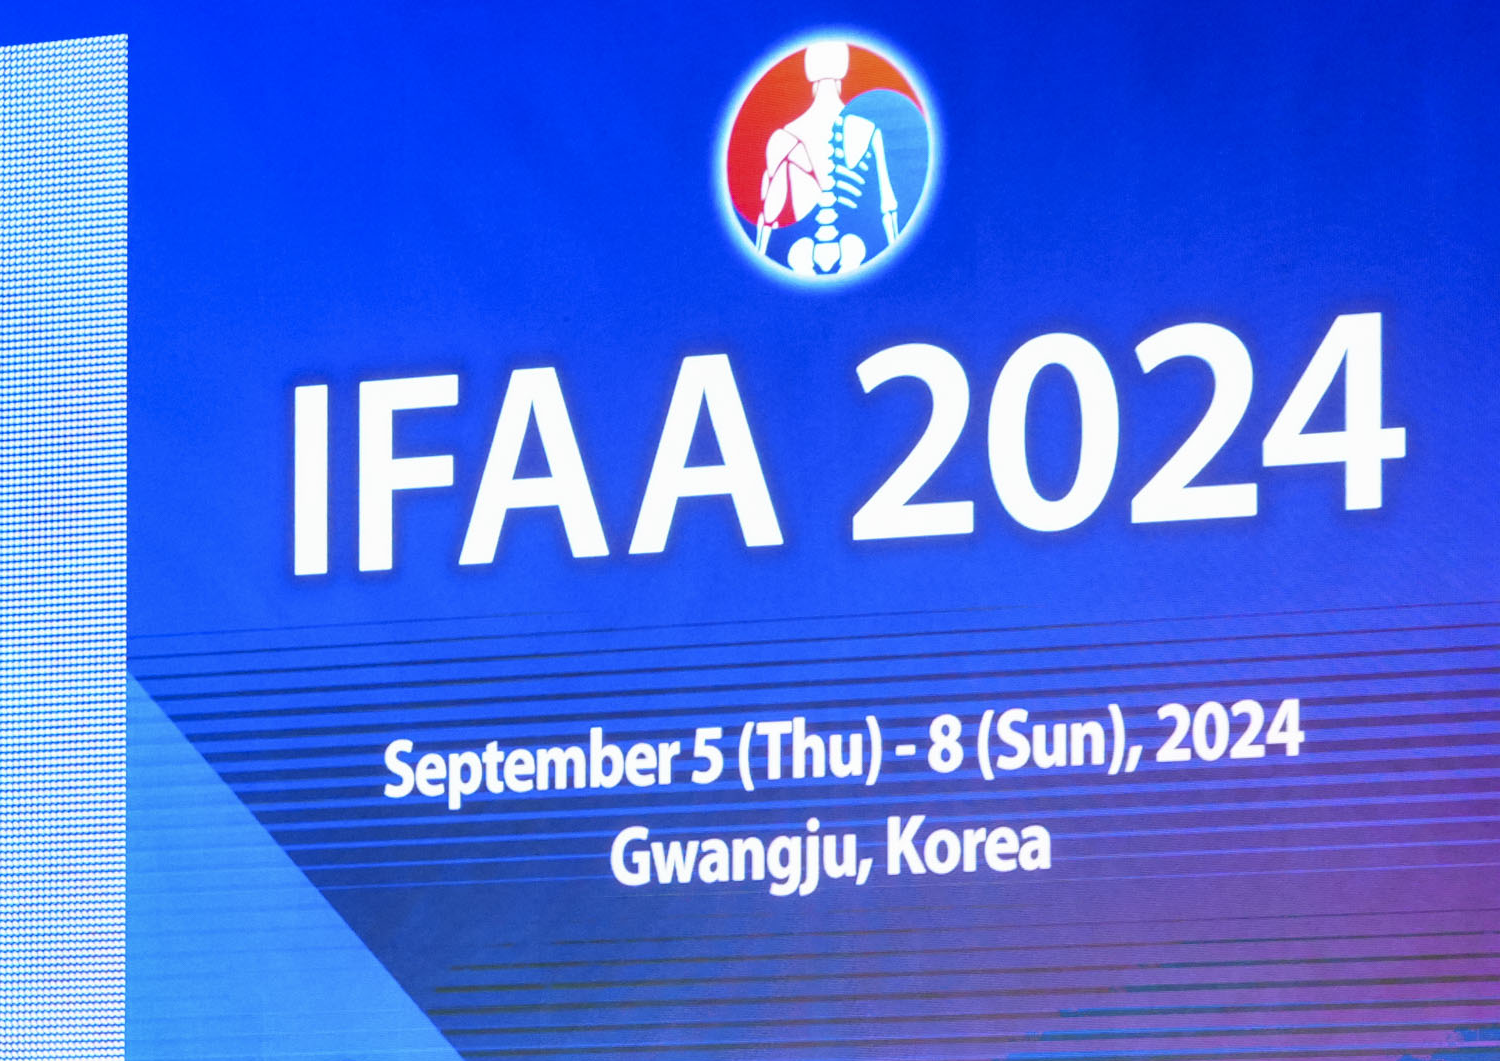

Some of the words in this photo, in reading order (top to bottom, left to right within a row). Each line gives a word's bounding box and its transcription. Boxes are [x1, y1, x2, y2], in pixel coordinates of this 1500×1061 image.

[294, 353, 784, 576] IFAA
[852, 312, 1406, 541] 2024
[384, 727, 681, 810] September
[692, 726, 725, 785] 5
[738, 716, 882, 792] (Thu)
[927, 713, 964, 774] 8
[977, 703, 1143, 781] (Sun),
[1156, 698, 1305, 763] 2024
[610, 817, 873, 897] Gwangju,
[887, 814, 1052, 876] Korea
